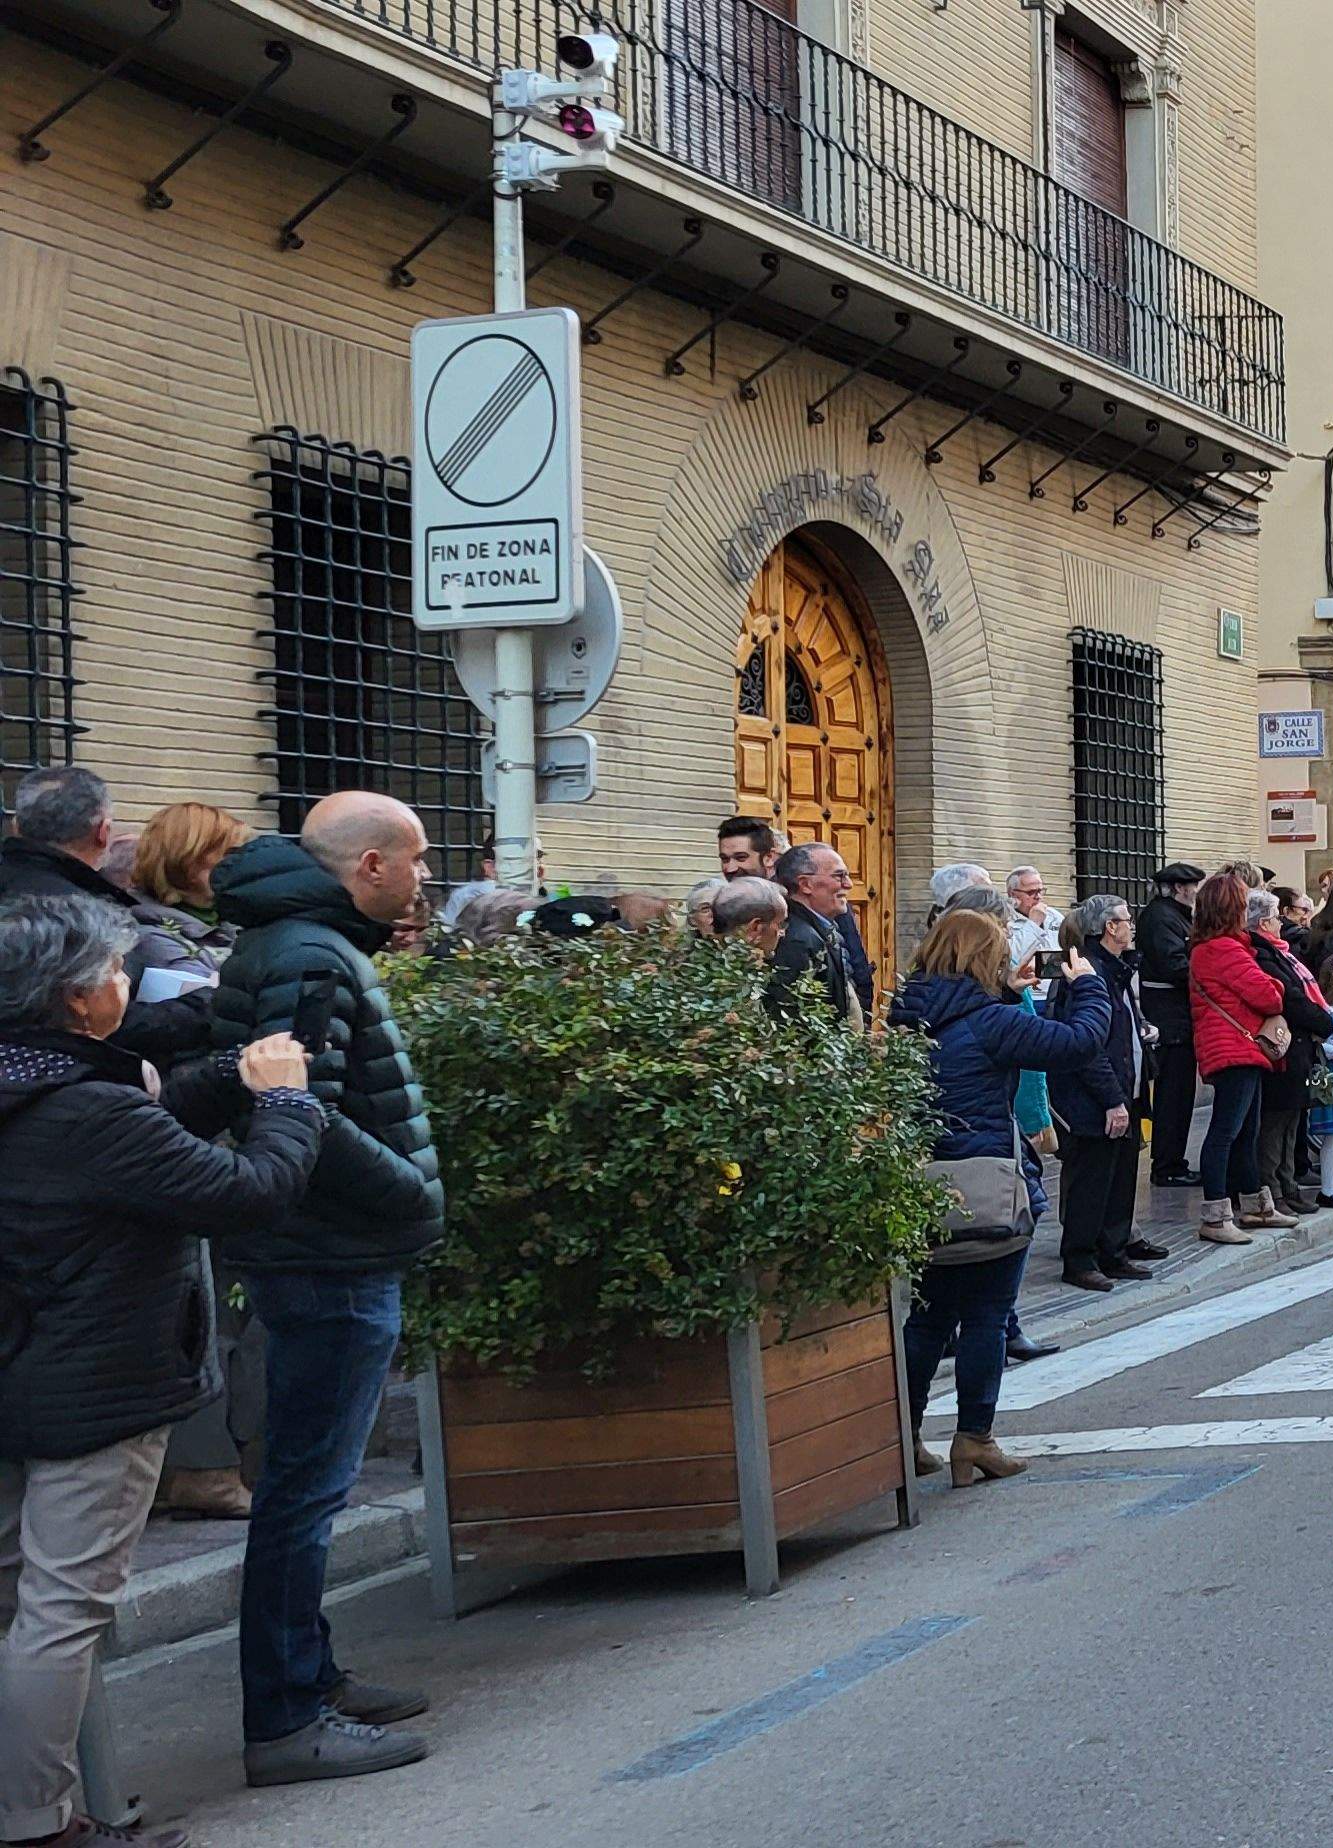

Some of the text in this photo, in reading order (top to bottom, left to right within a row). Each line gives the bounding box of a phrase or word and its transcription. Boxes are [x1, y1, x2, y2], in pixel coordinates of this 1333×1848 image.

[431, 538, 552, 562] FIN DE ZONA
[1284, 717, 1313, 728] CALLE
[1281, 728, 1309, 739] SAN
[1266, 738, 1315, 751] JORGE
